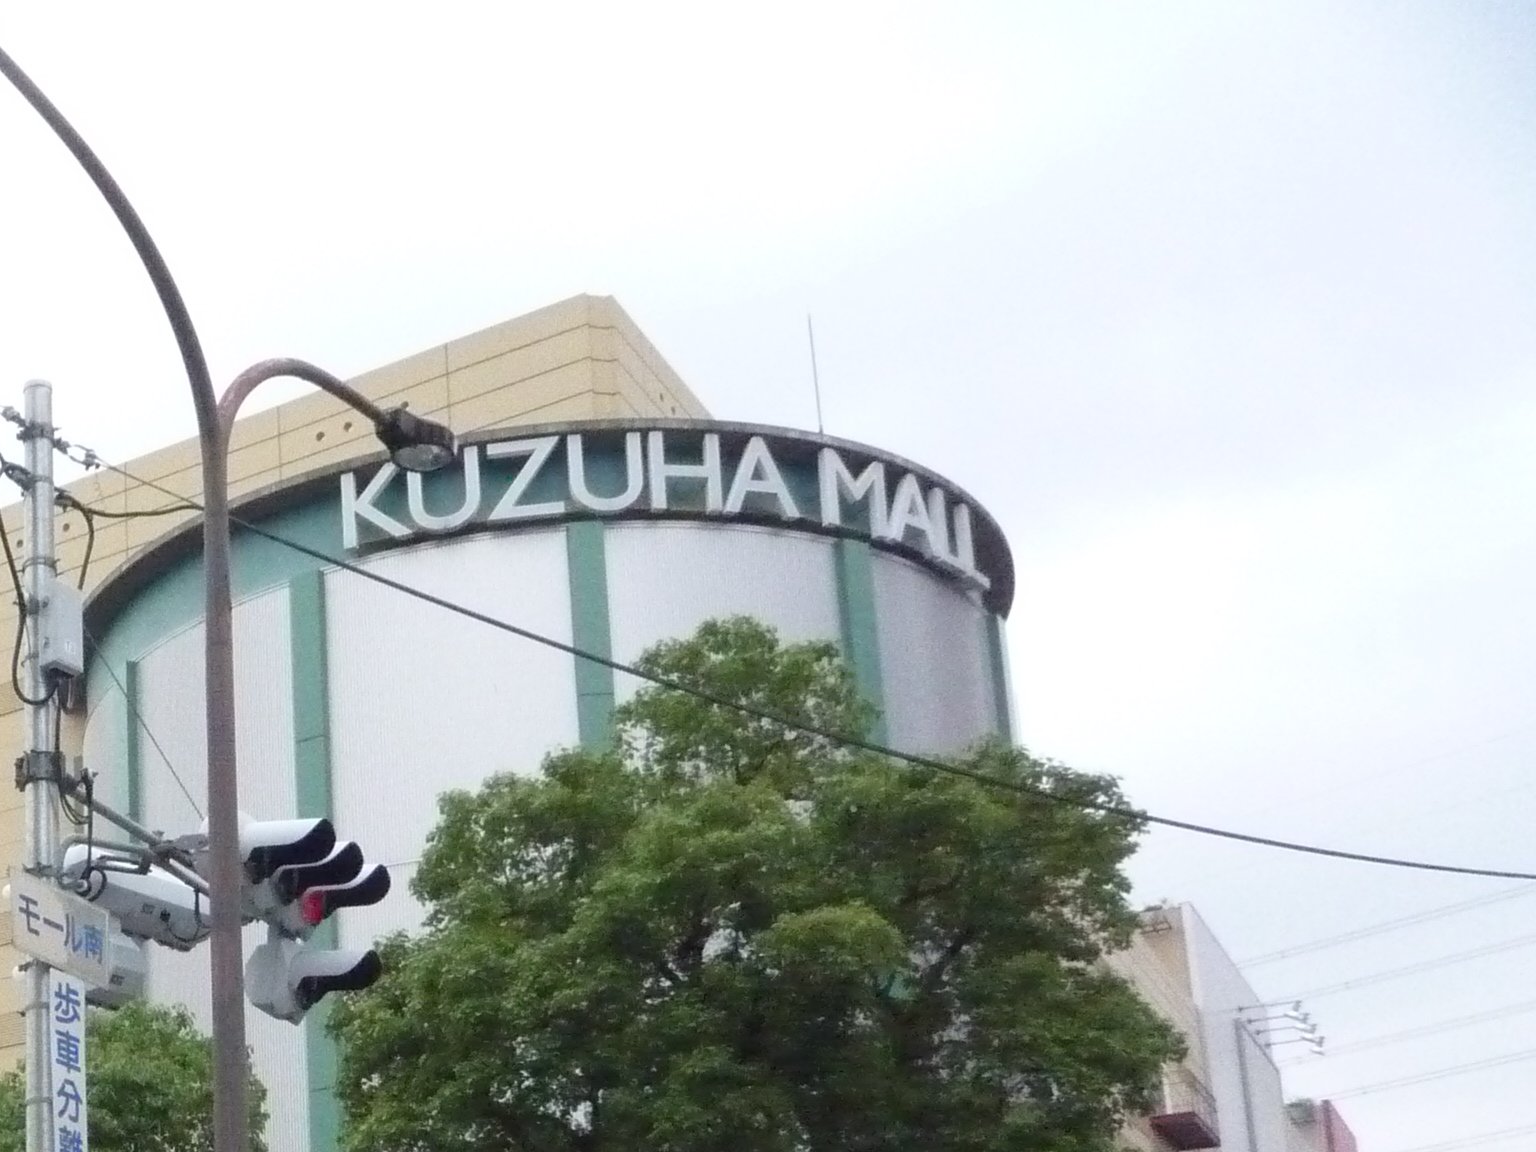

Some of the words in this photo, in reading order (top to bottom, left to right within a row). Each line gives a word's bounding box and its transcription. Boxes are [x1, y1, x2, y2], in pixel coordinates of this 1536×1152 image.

[340, 430, 800, 549] KUZUHA
[817, 447, 991, 592] MALL
[18, 893, 104, 965] モール南
